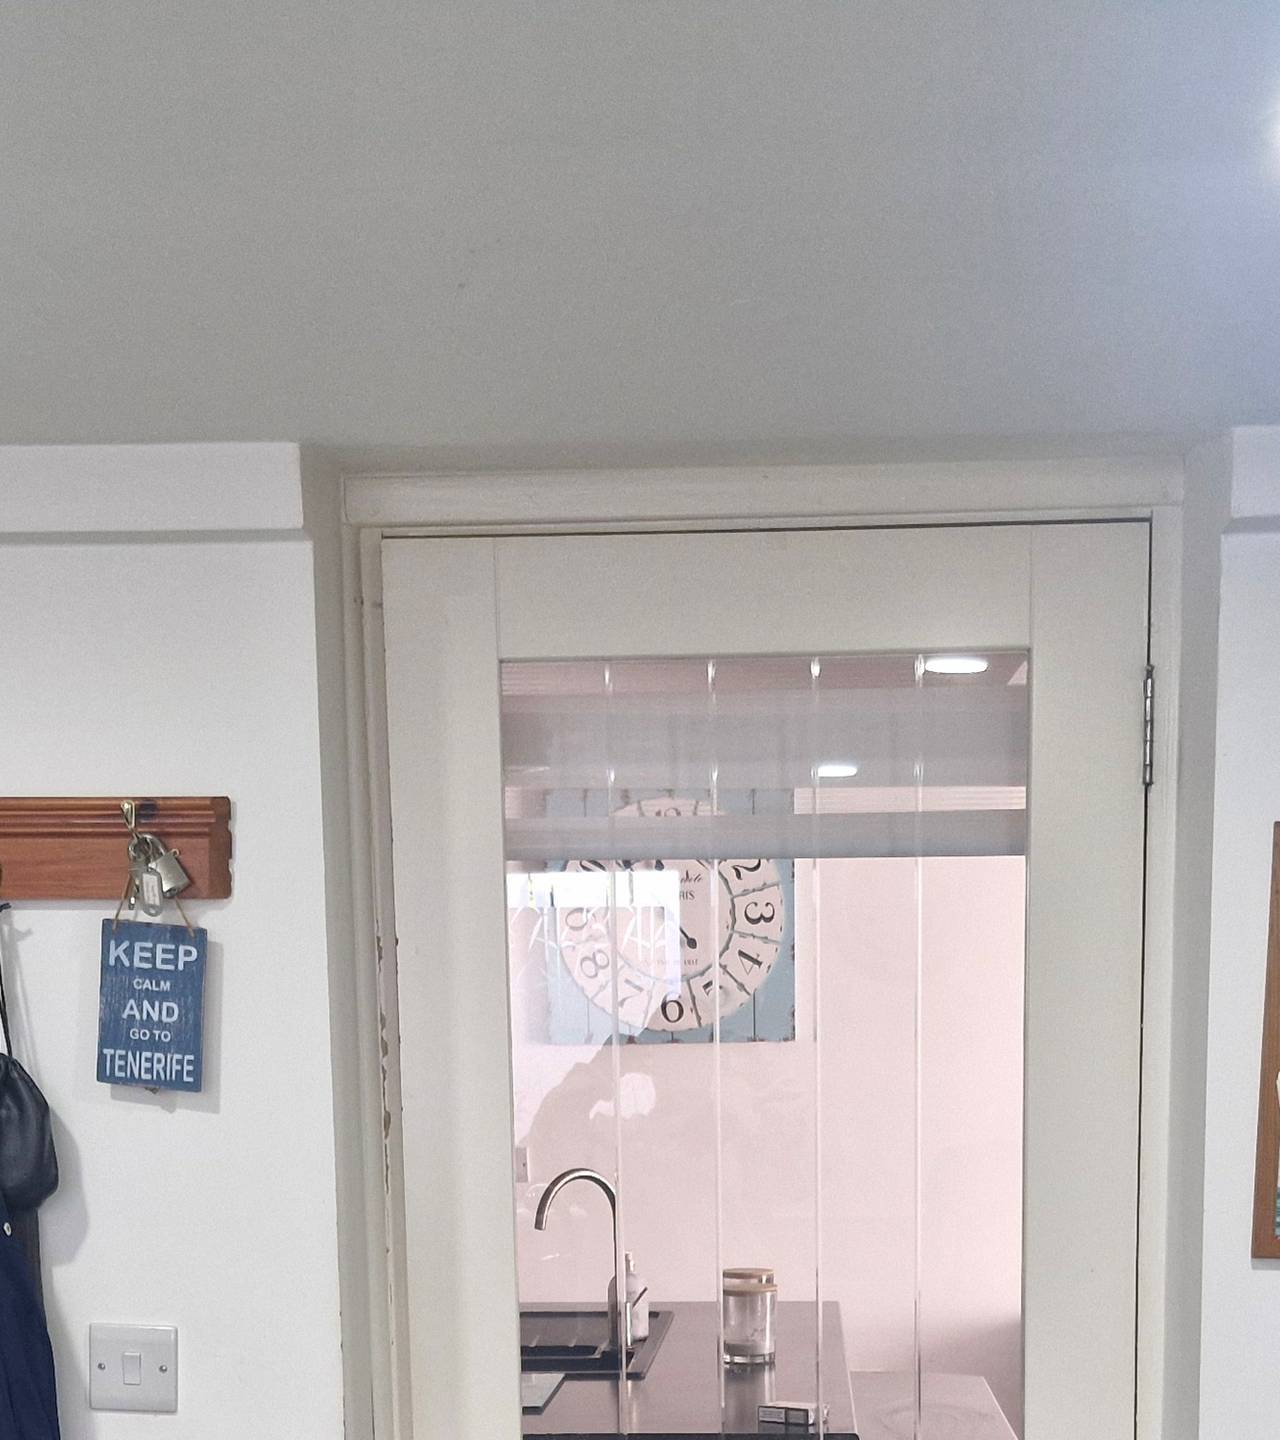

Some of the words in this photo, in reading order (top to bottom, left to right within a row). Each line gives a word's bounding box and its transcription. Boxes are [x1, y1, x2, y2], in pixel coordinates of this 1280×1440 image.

[744, 901, 775, 925] 3
[108, 939, 198, 971] KEEP
[580, 949, 609, 978] 8
[738, 949, 762, 976] 4
[133, 978, 171, 992] CALM
[121, 998, 180, 1023] AND
[660, 992, 684, 1023] 6
[129, 1028, 150, 1040] GO
[152, 1029, 171, 1042] TO
[103, 1048, 195, 1082] TENERIFE
